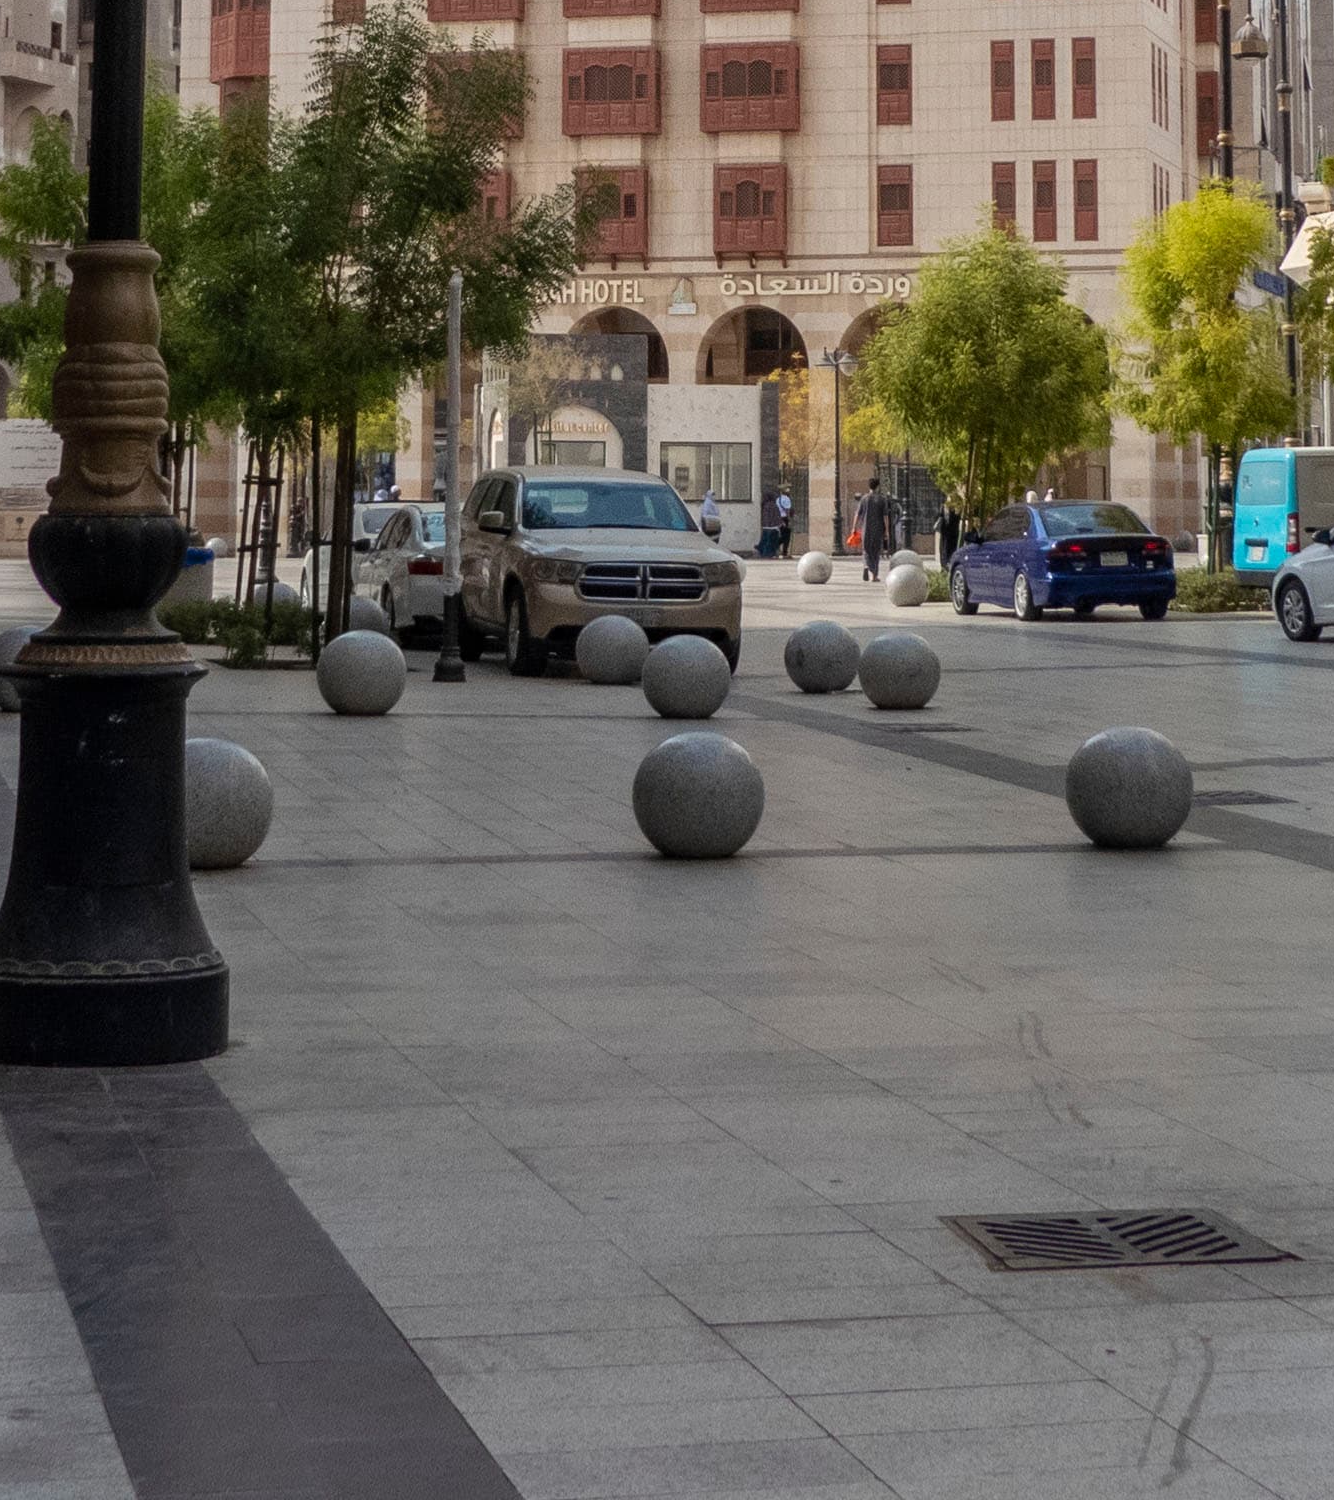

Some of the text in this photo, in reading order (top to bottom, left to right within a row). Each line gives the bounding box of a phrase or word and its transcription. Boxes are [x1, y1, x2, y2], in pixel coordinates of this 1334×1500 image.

[581, 279, 644, 304] HOTEL
[719, 271, 912, 299] وردة السعادة
